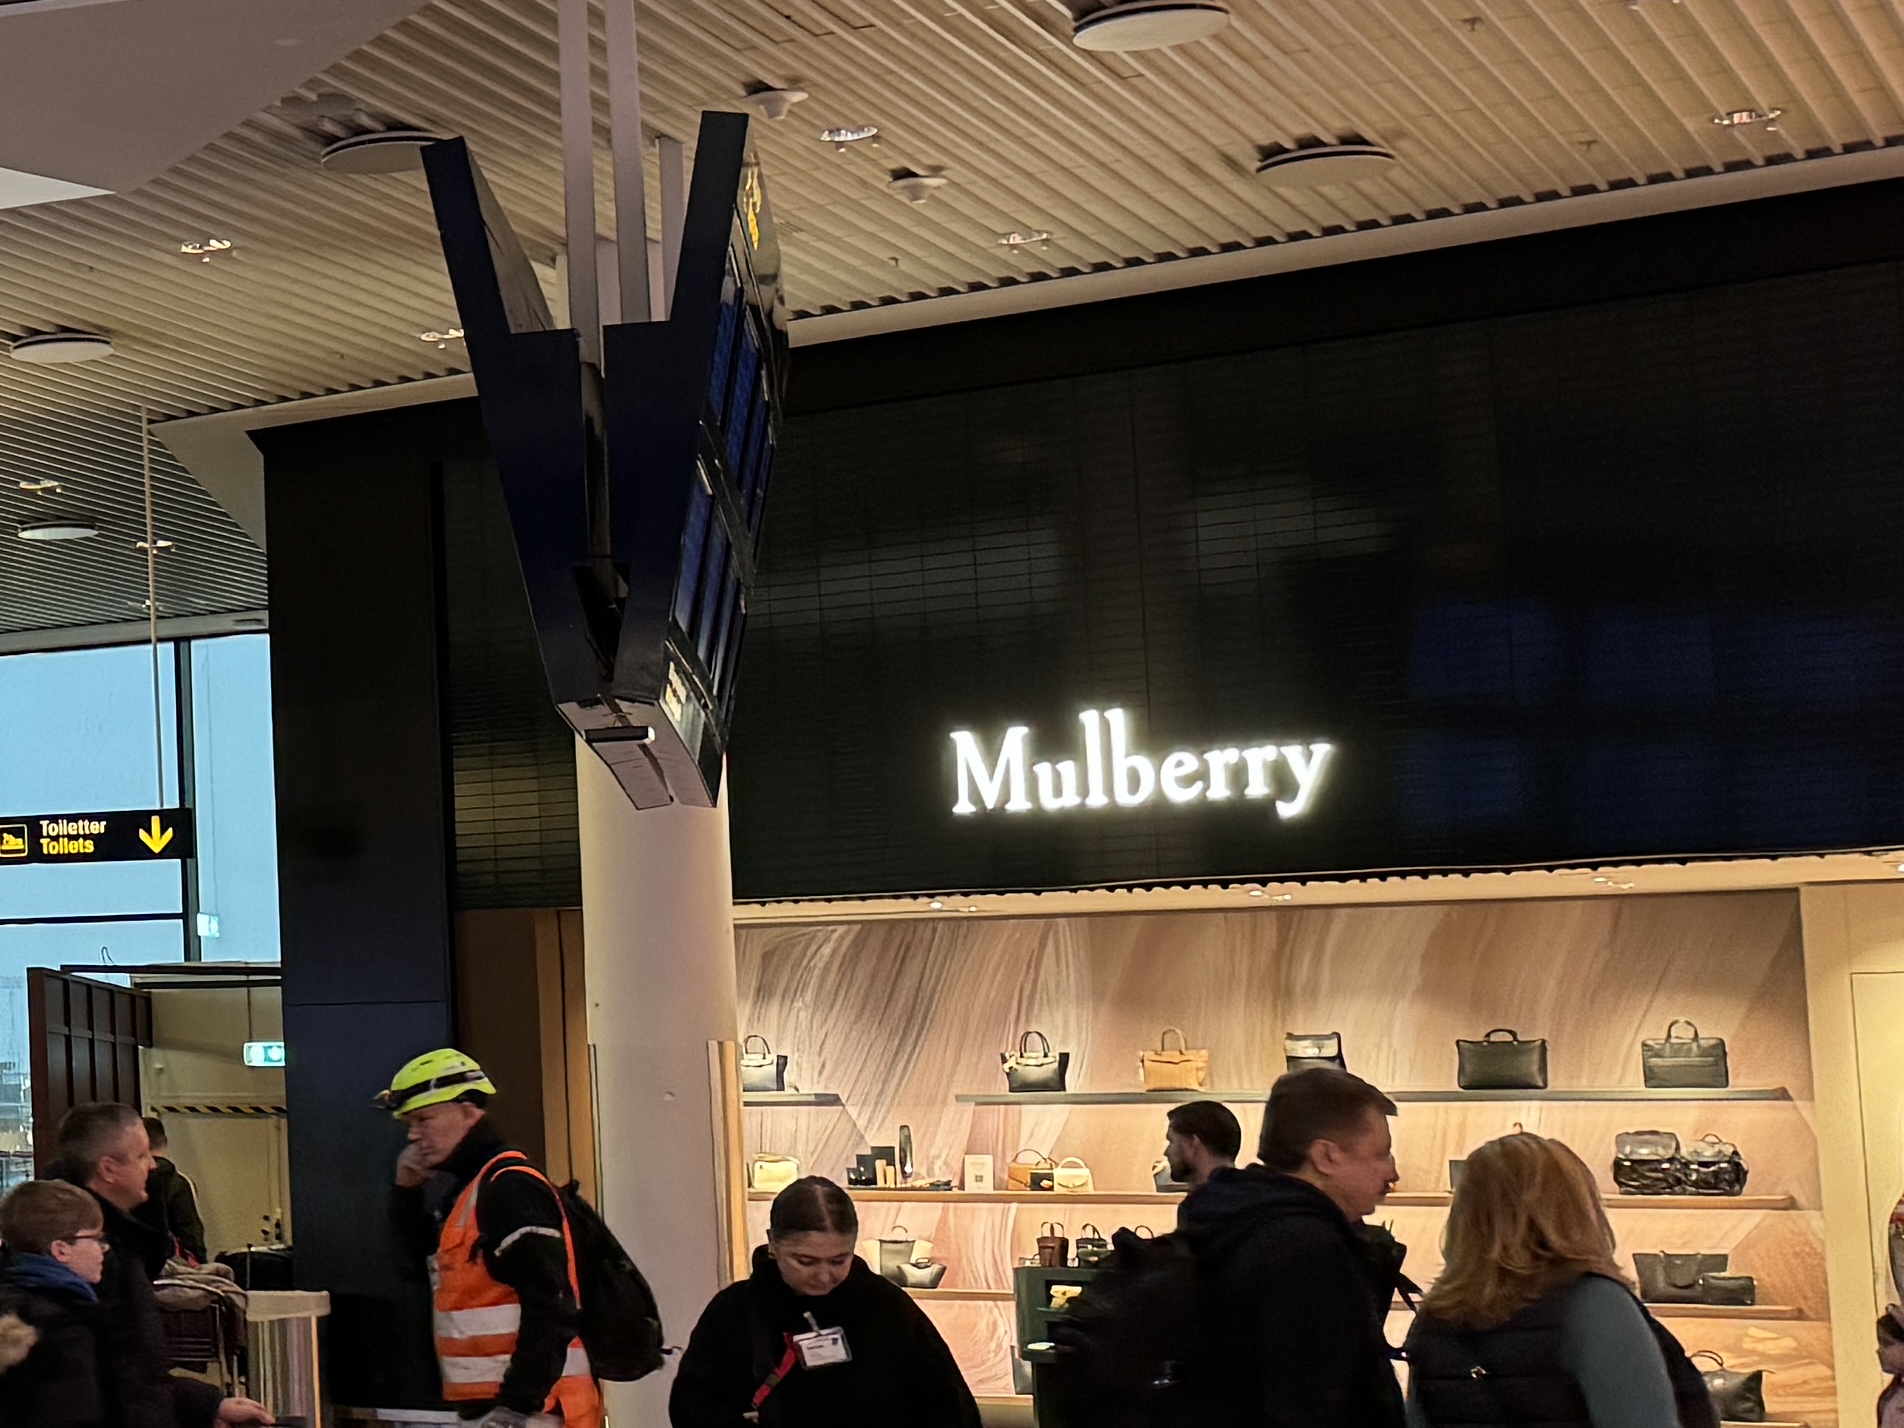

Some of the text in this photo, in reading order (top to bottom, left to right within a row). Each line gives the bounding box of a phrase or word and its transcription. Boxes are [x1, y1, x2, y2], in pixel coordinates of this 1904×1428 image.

[949, 706, 1337, 821] Mulberry
[39, 819, 107, 837] Toiletter
[39, 837, 95, 855] Toilets
